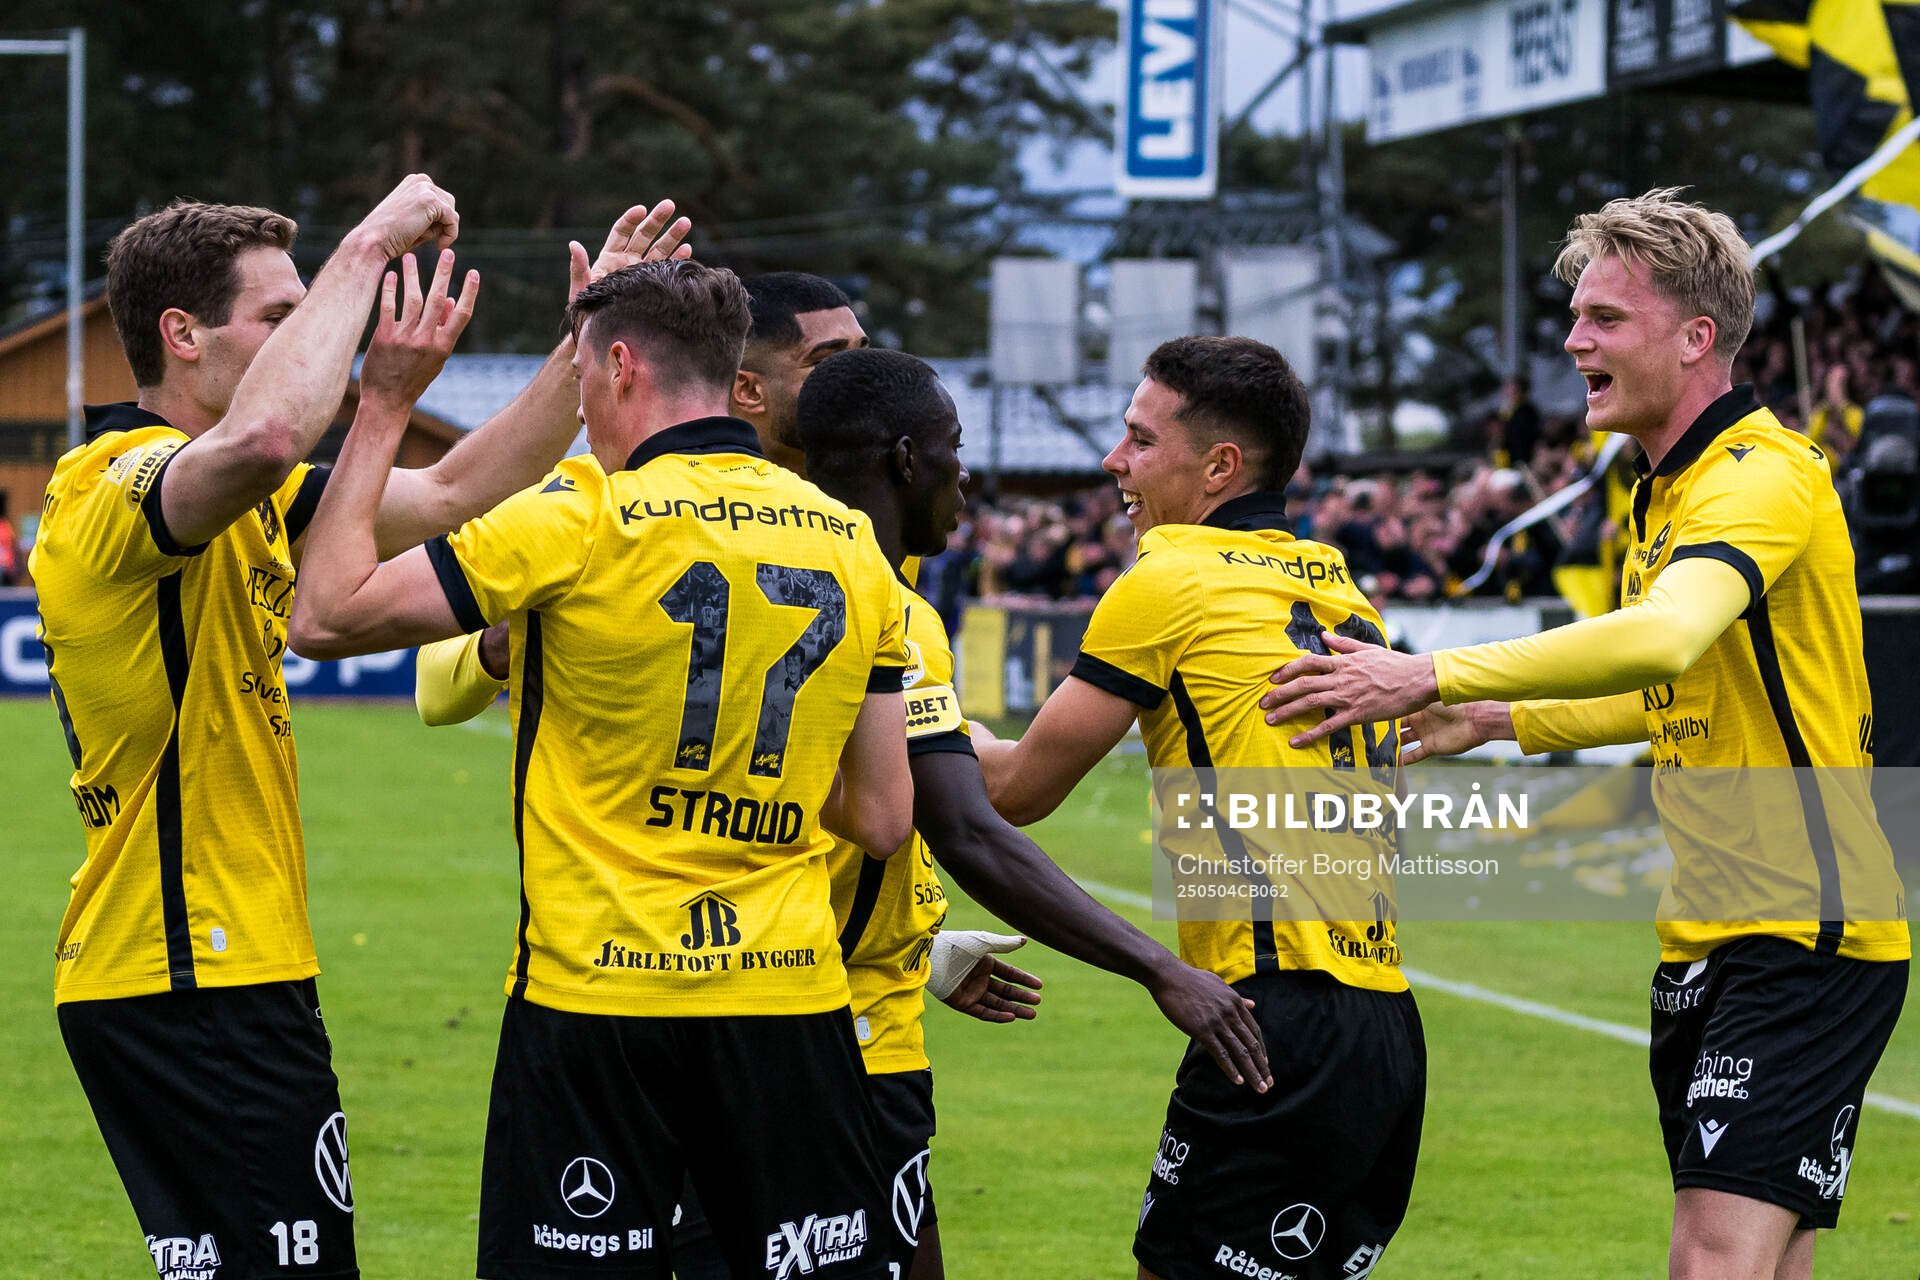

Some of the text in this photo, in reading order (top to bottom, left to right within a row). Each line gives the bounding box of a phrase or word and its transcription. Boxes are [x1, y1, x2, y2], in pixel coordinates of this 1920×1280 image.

[658, 561, 846, 778] 17
[646, 785, 804, 845] STROUD
[593, 938, 817, 973] JÄRLETOFT BYGGER
[269, 1220, 319, 1266] 18
[533, 1224, 653, 1258] Råbergs Bil
[766, 1208, 868, 1280] EXTRA
[818, 1244, 864, 1267] MJÄLLBY
